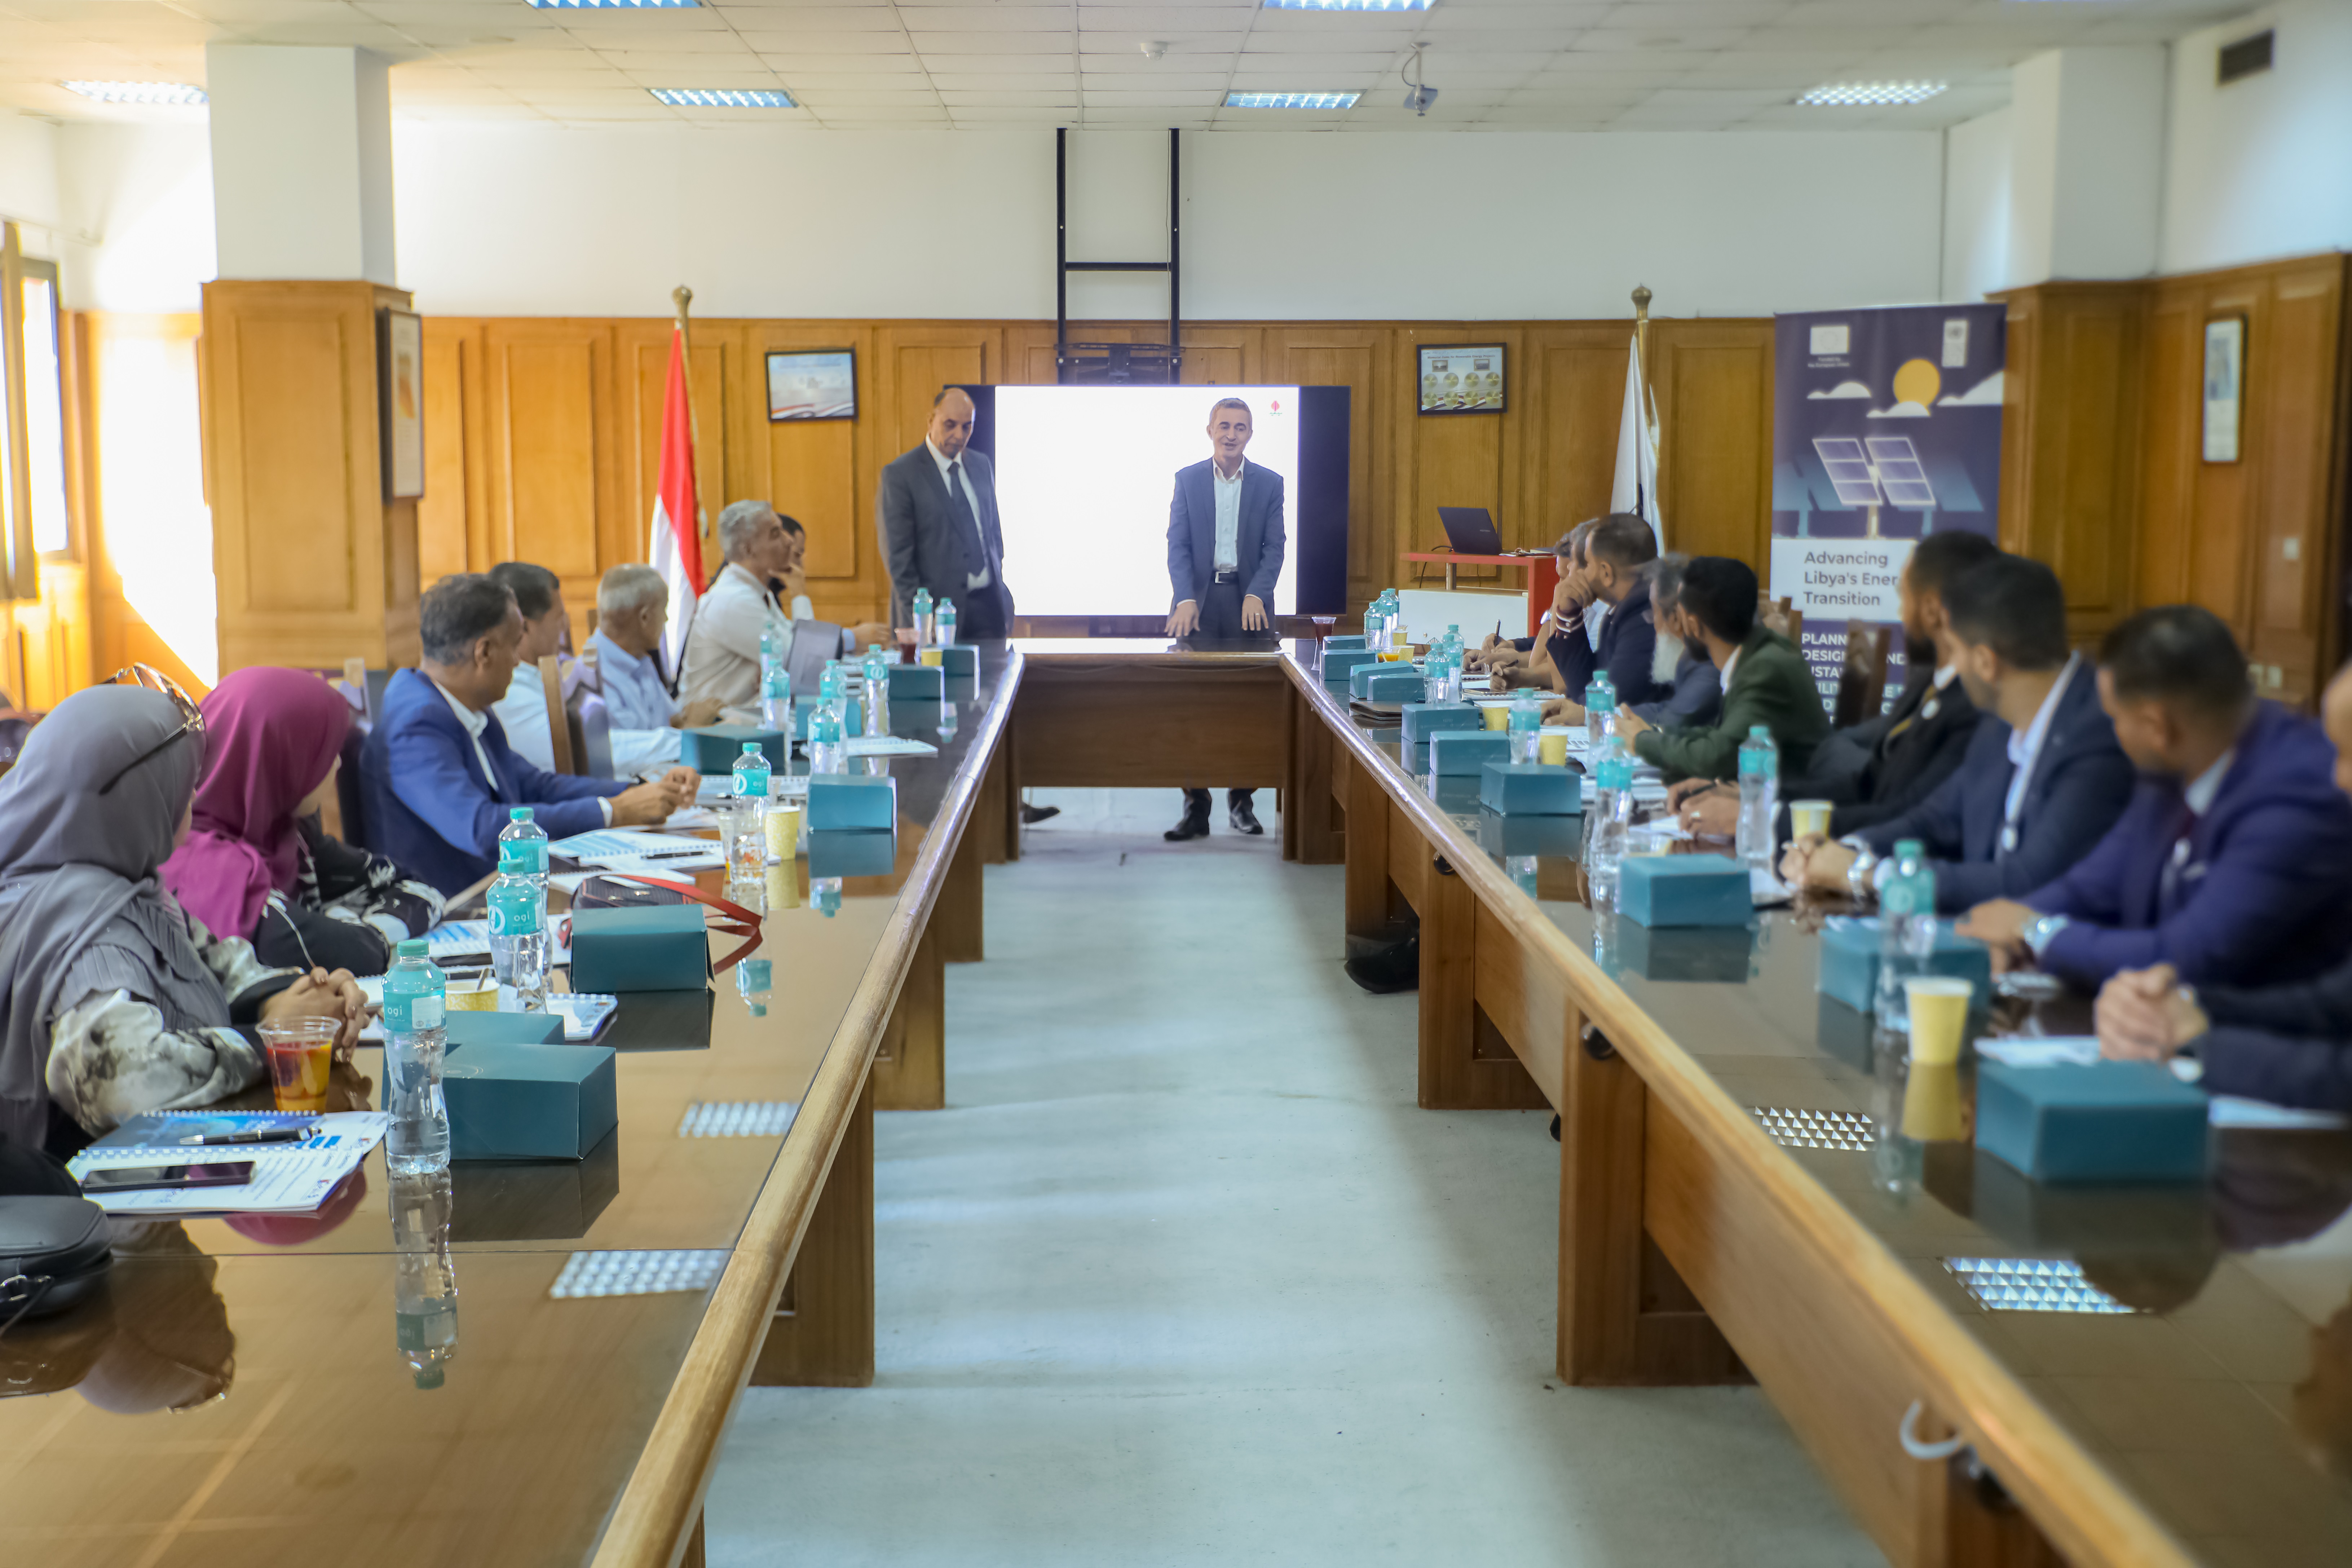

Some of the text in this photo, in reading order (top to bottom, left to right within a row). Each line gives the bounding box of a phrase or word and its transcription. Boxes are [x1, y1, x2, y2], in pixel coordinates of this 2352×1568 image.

[1804, 551, 1888, 568] Advancing
[1804, 570, 1898, 587] Libya's Ener
[1803, 591, 1881, 606] Transition
[1801, 633, 1848, 645] PLANN
[1801, 649, 1906, 665] DESIG ND
